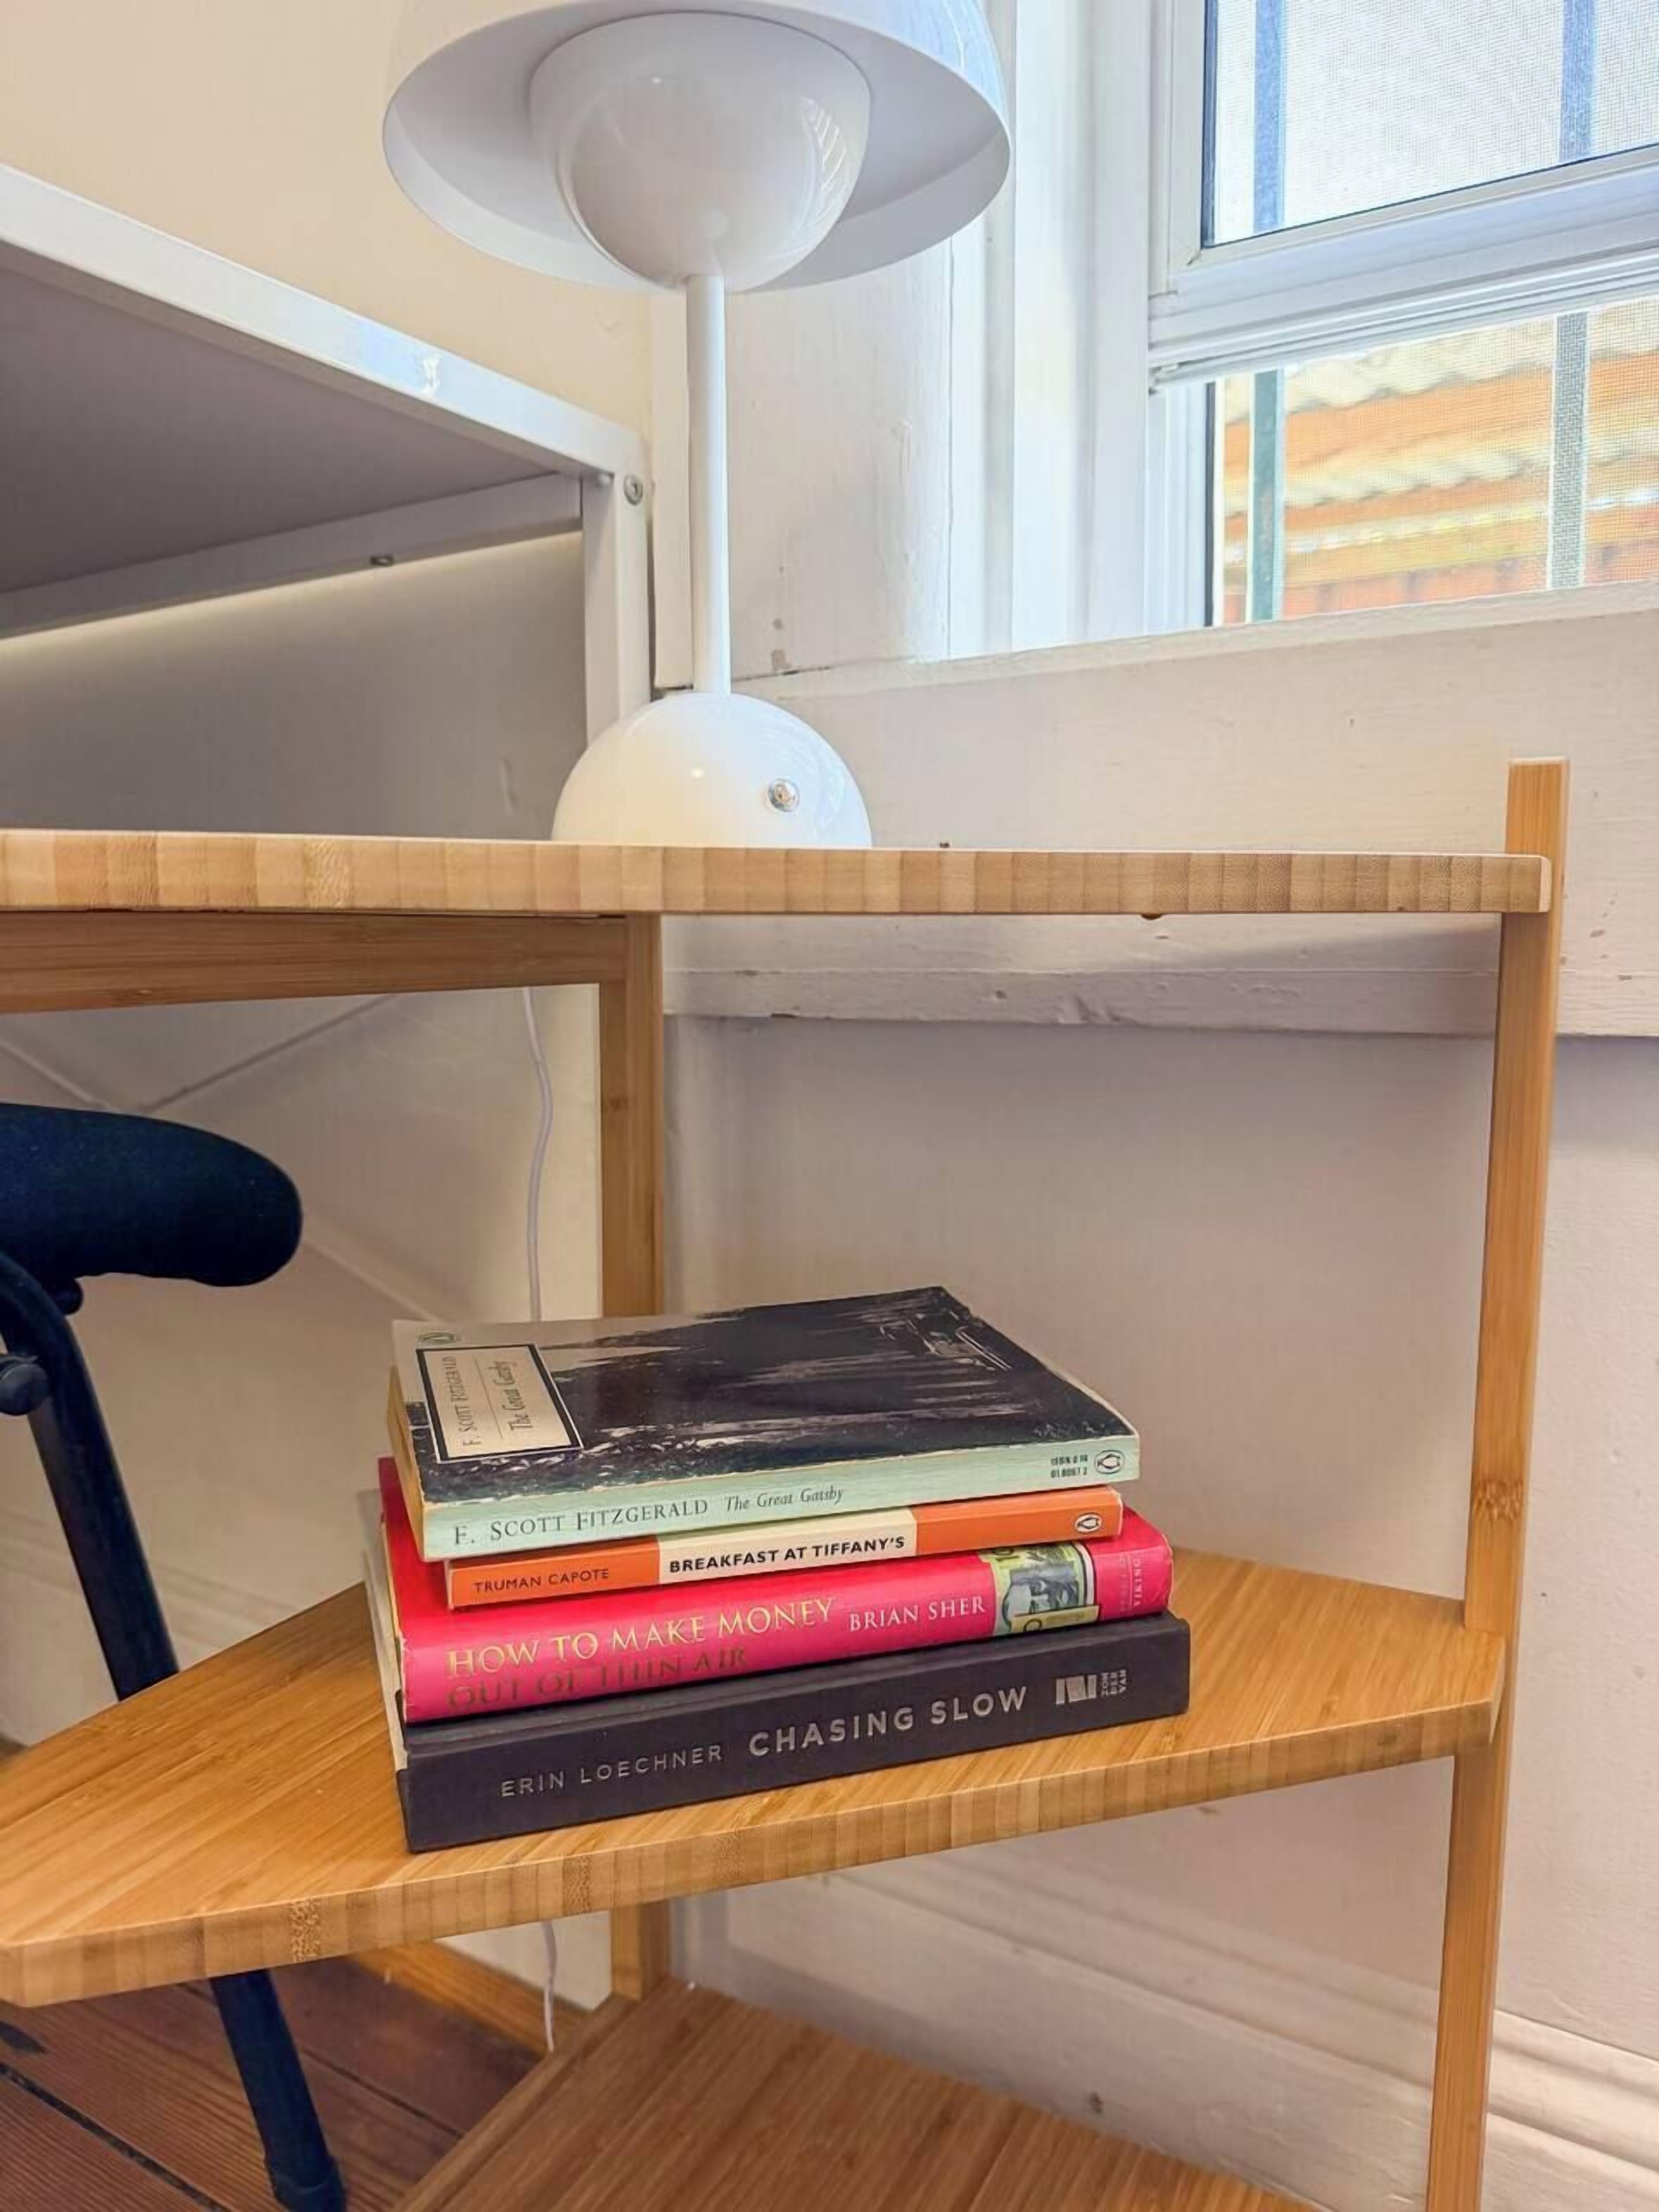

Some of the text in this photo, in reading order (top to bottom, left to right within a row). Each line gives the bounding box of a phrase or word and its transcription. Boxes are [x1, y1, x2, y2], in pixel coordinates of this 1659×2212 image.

[454, 1485, 843, 1545] F. SCOTT FITZGERALD The Great Gatsby
[474, 1568, 609, 1595] TRUMAN CAPOTE
[670, 1536, 905, 1573] BREAKFAST AT TIFFANY'S
[447, 1597, 835, 1677] HOW TO MAKE MONEY
[849, 1596, 985, 1632] BRIAN SHER
[447, 1677, 523, 1708] OUT
[537, 1670, 584, 1700] OF
[692, 1647, 750, 1673] AIR
[749, 1686, 1027, 1757] CHASING SLOW
[501, 1745, 723, 1798] ERIN LOECHNER
